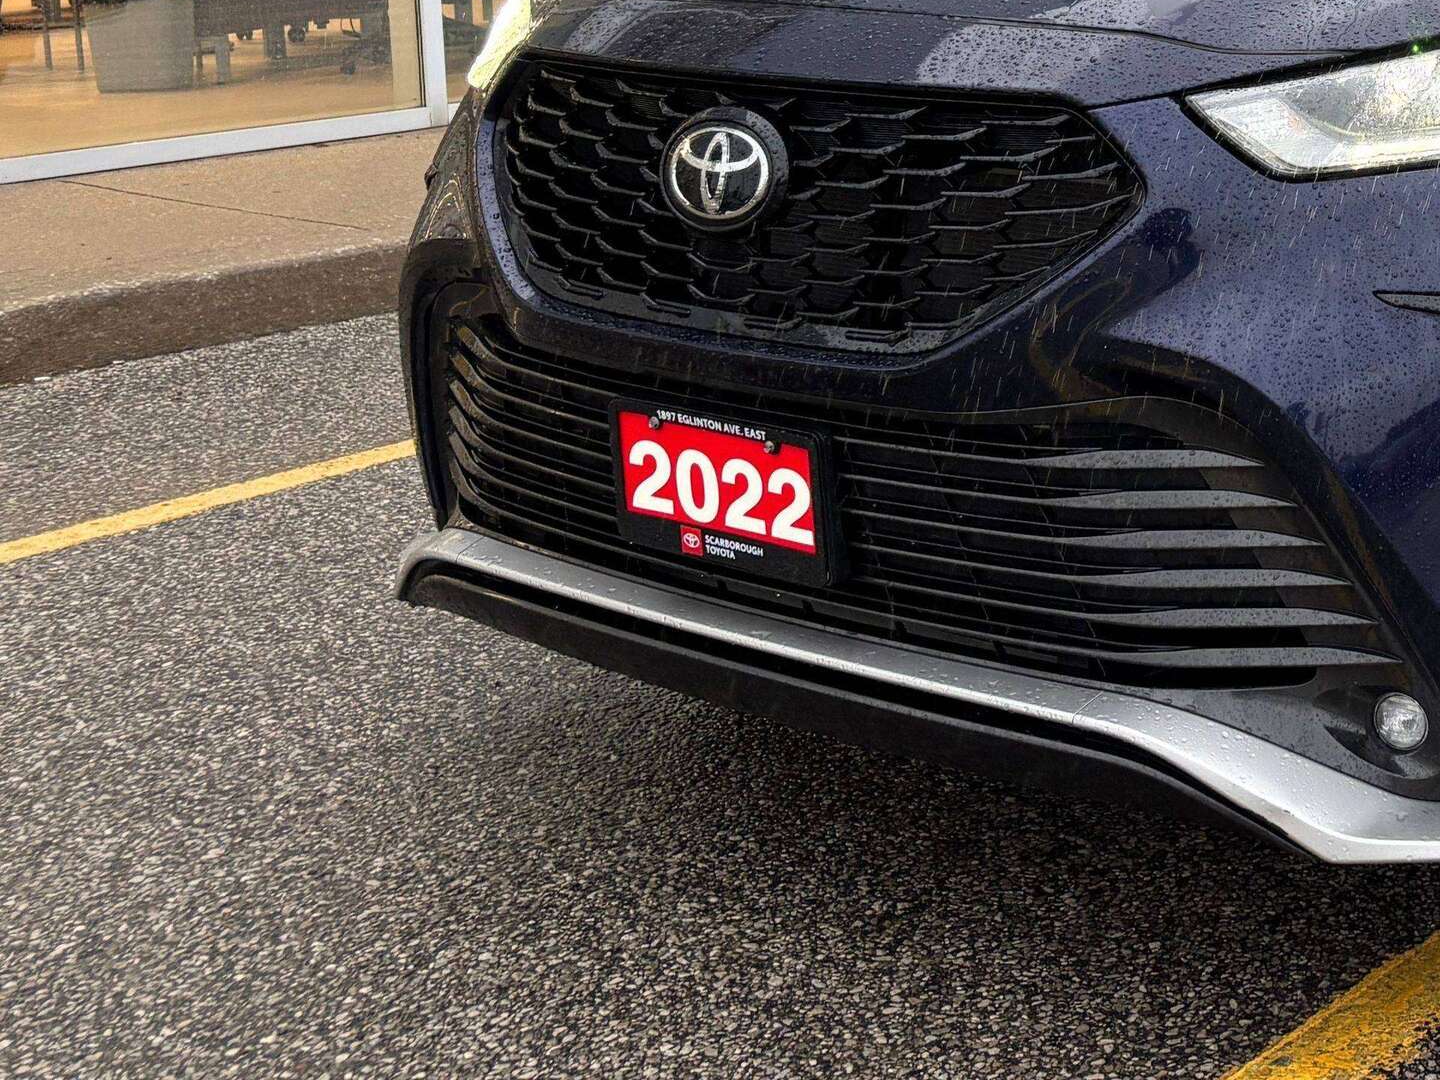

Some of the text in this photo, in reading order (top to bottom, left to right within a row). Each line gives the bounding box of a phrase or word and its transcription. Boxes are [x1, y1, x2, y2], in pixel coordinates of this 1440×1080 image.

[656, 409, 767, 441] 1897 EGLINTON AVE. EAST
[628, 439, 815, 547] 2022
[704, 534, 764, 557] SCARBOROUGH
[706, 544, 736, 560] TOYOTA
